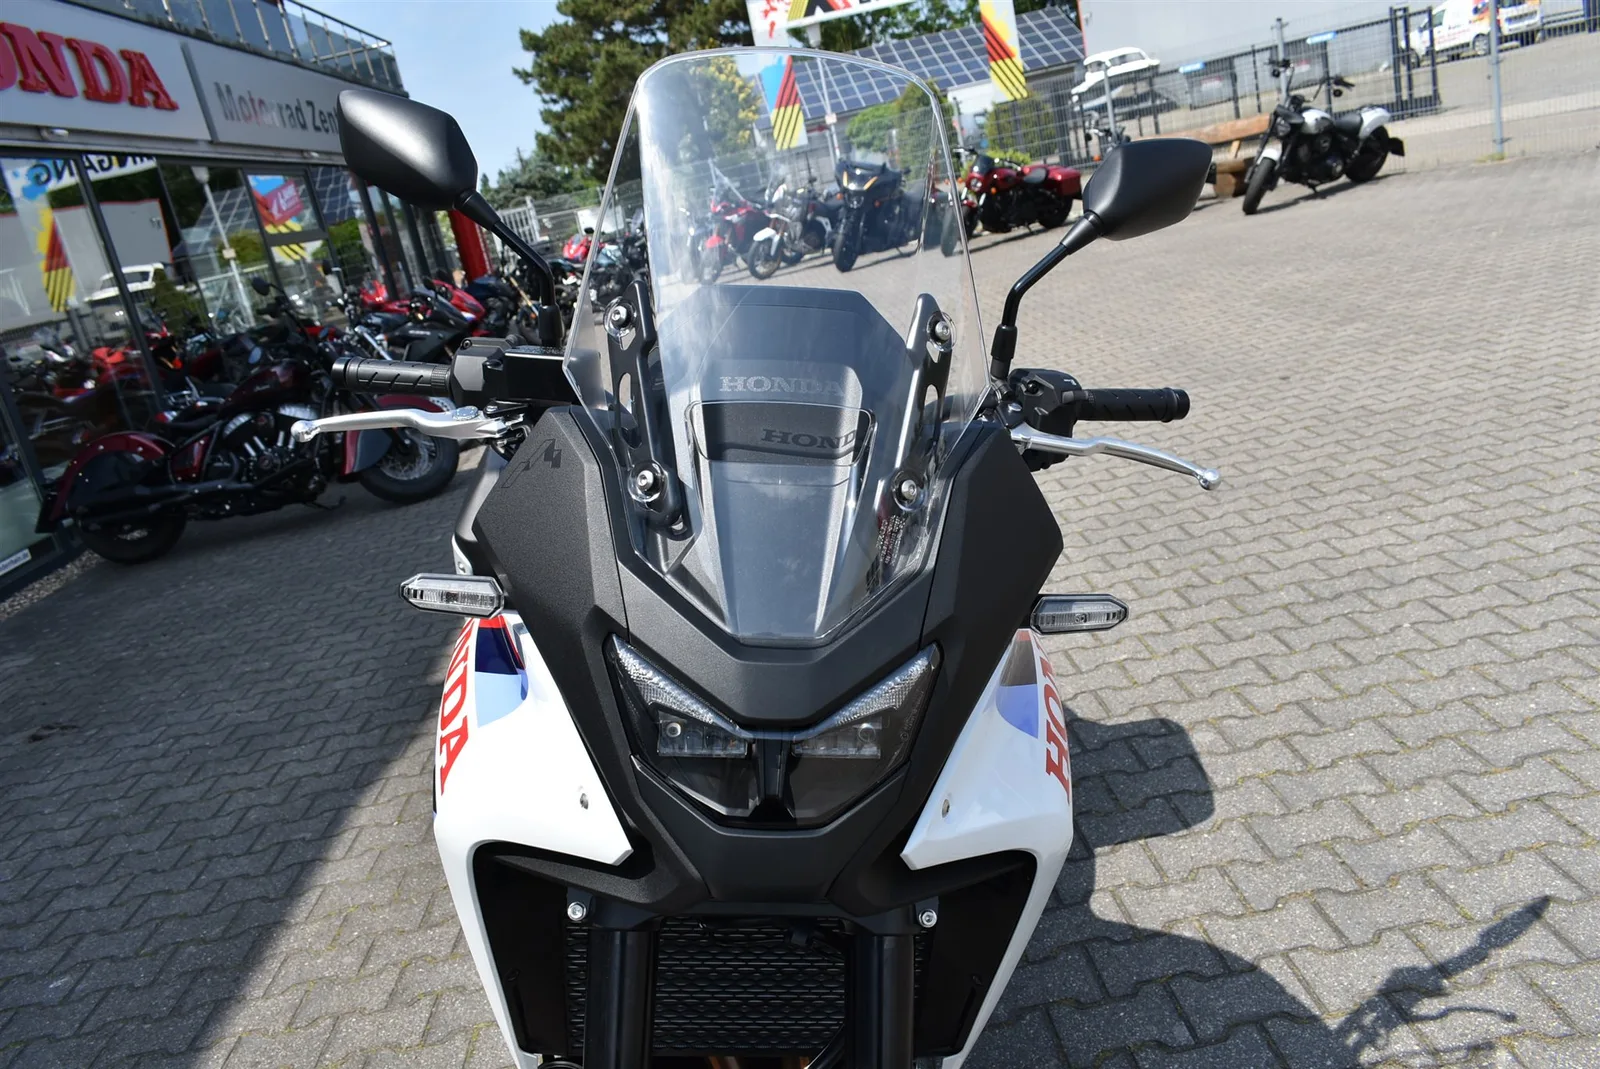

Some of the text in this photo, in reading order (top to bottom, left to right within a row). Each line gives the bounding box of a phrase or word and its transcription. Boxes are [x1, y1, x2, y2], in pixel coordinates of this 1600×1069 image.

[214, 82, 308, 130] Motorrad
[719, 376, 845, 396] HONDA
[761, 429, 856, 450] HOND
[440, 617, 475, 796] NDA
